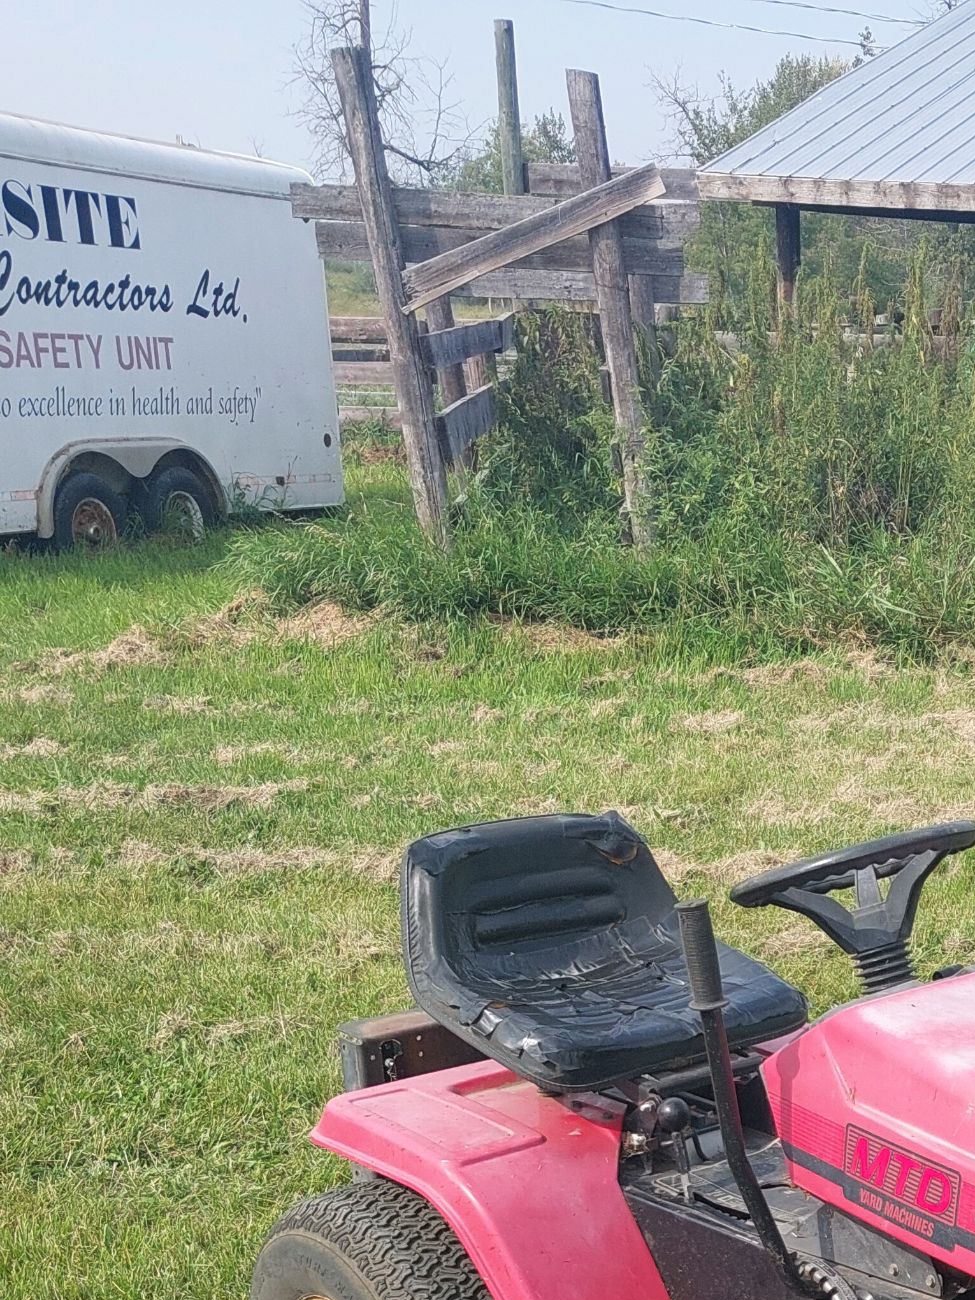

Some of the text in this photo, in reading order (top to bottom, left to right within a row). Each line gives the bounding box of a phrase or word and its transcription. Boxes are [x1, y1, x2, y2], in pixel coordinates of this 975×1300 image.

[0, 179, 141, 249] SITE
[0, 250, 248, 323] Contractors Ltd.
[0, 329, 174, 370] SAFETY UNIT
[18, 386, 103, 417] excellence
[109, 388, 126, 416] in
[131, 386, 181, 416] health
[186, 387, 213, 415] and
[850, 1136, 952, 1215] MTD
[860, 1187, 935, 1237] YARD MACHINES
